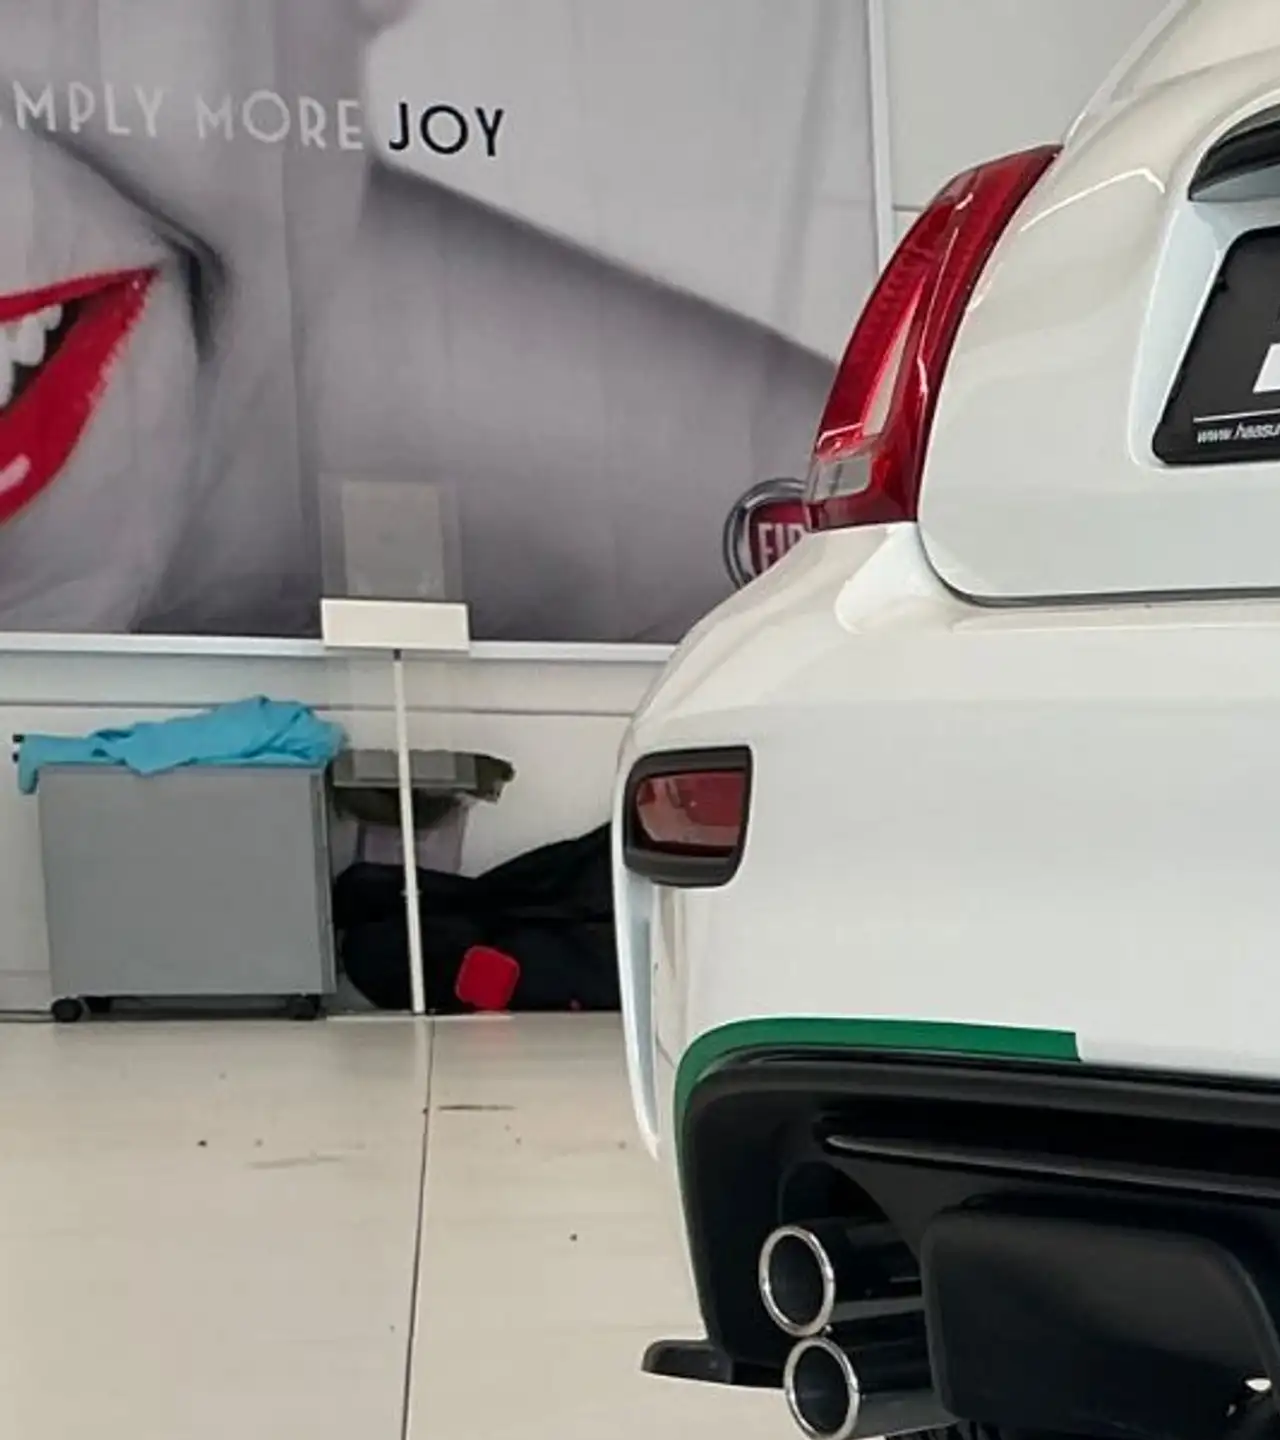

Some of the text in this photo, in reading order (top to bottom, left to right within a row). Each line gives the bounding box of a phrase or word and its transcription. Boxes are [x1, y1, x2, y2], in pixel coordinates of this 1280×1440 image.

[0, 79, 504, 157] MPLY MORE JOY
